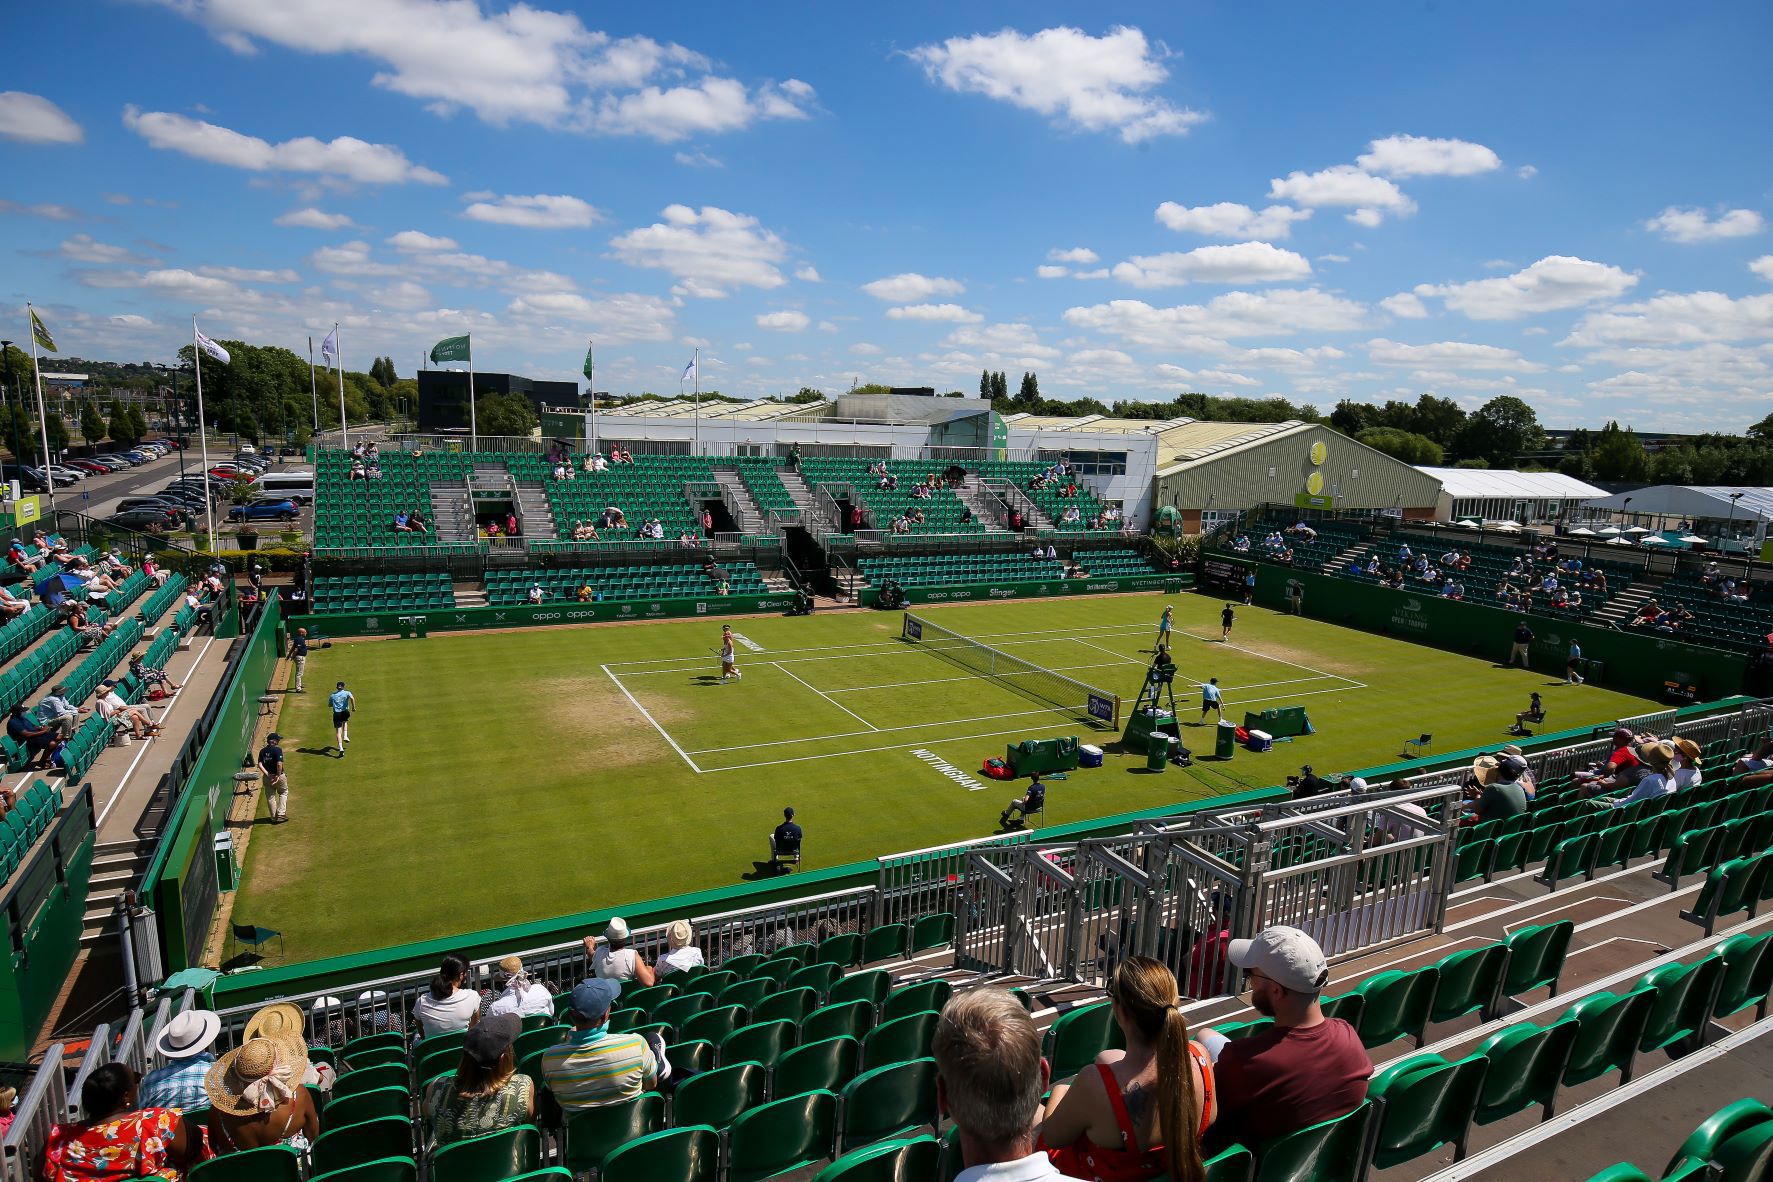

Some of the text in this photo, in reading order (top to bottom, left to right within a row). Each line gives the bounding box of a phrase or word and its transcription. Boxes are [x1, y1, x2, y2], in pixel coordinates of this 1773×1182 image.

[532, 612, 561, 621] oppo
[567, 610, 595, 619] oppo
[908, 748, 989, 792] NOTTINGHAM
